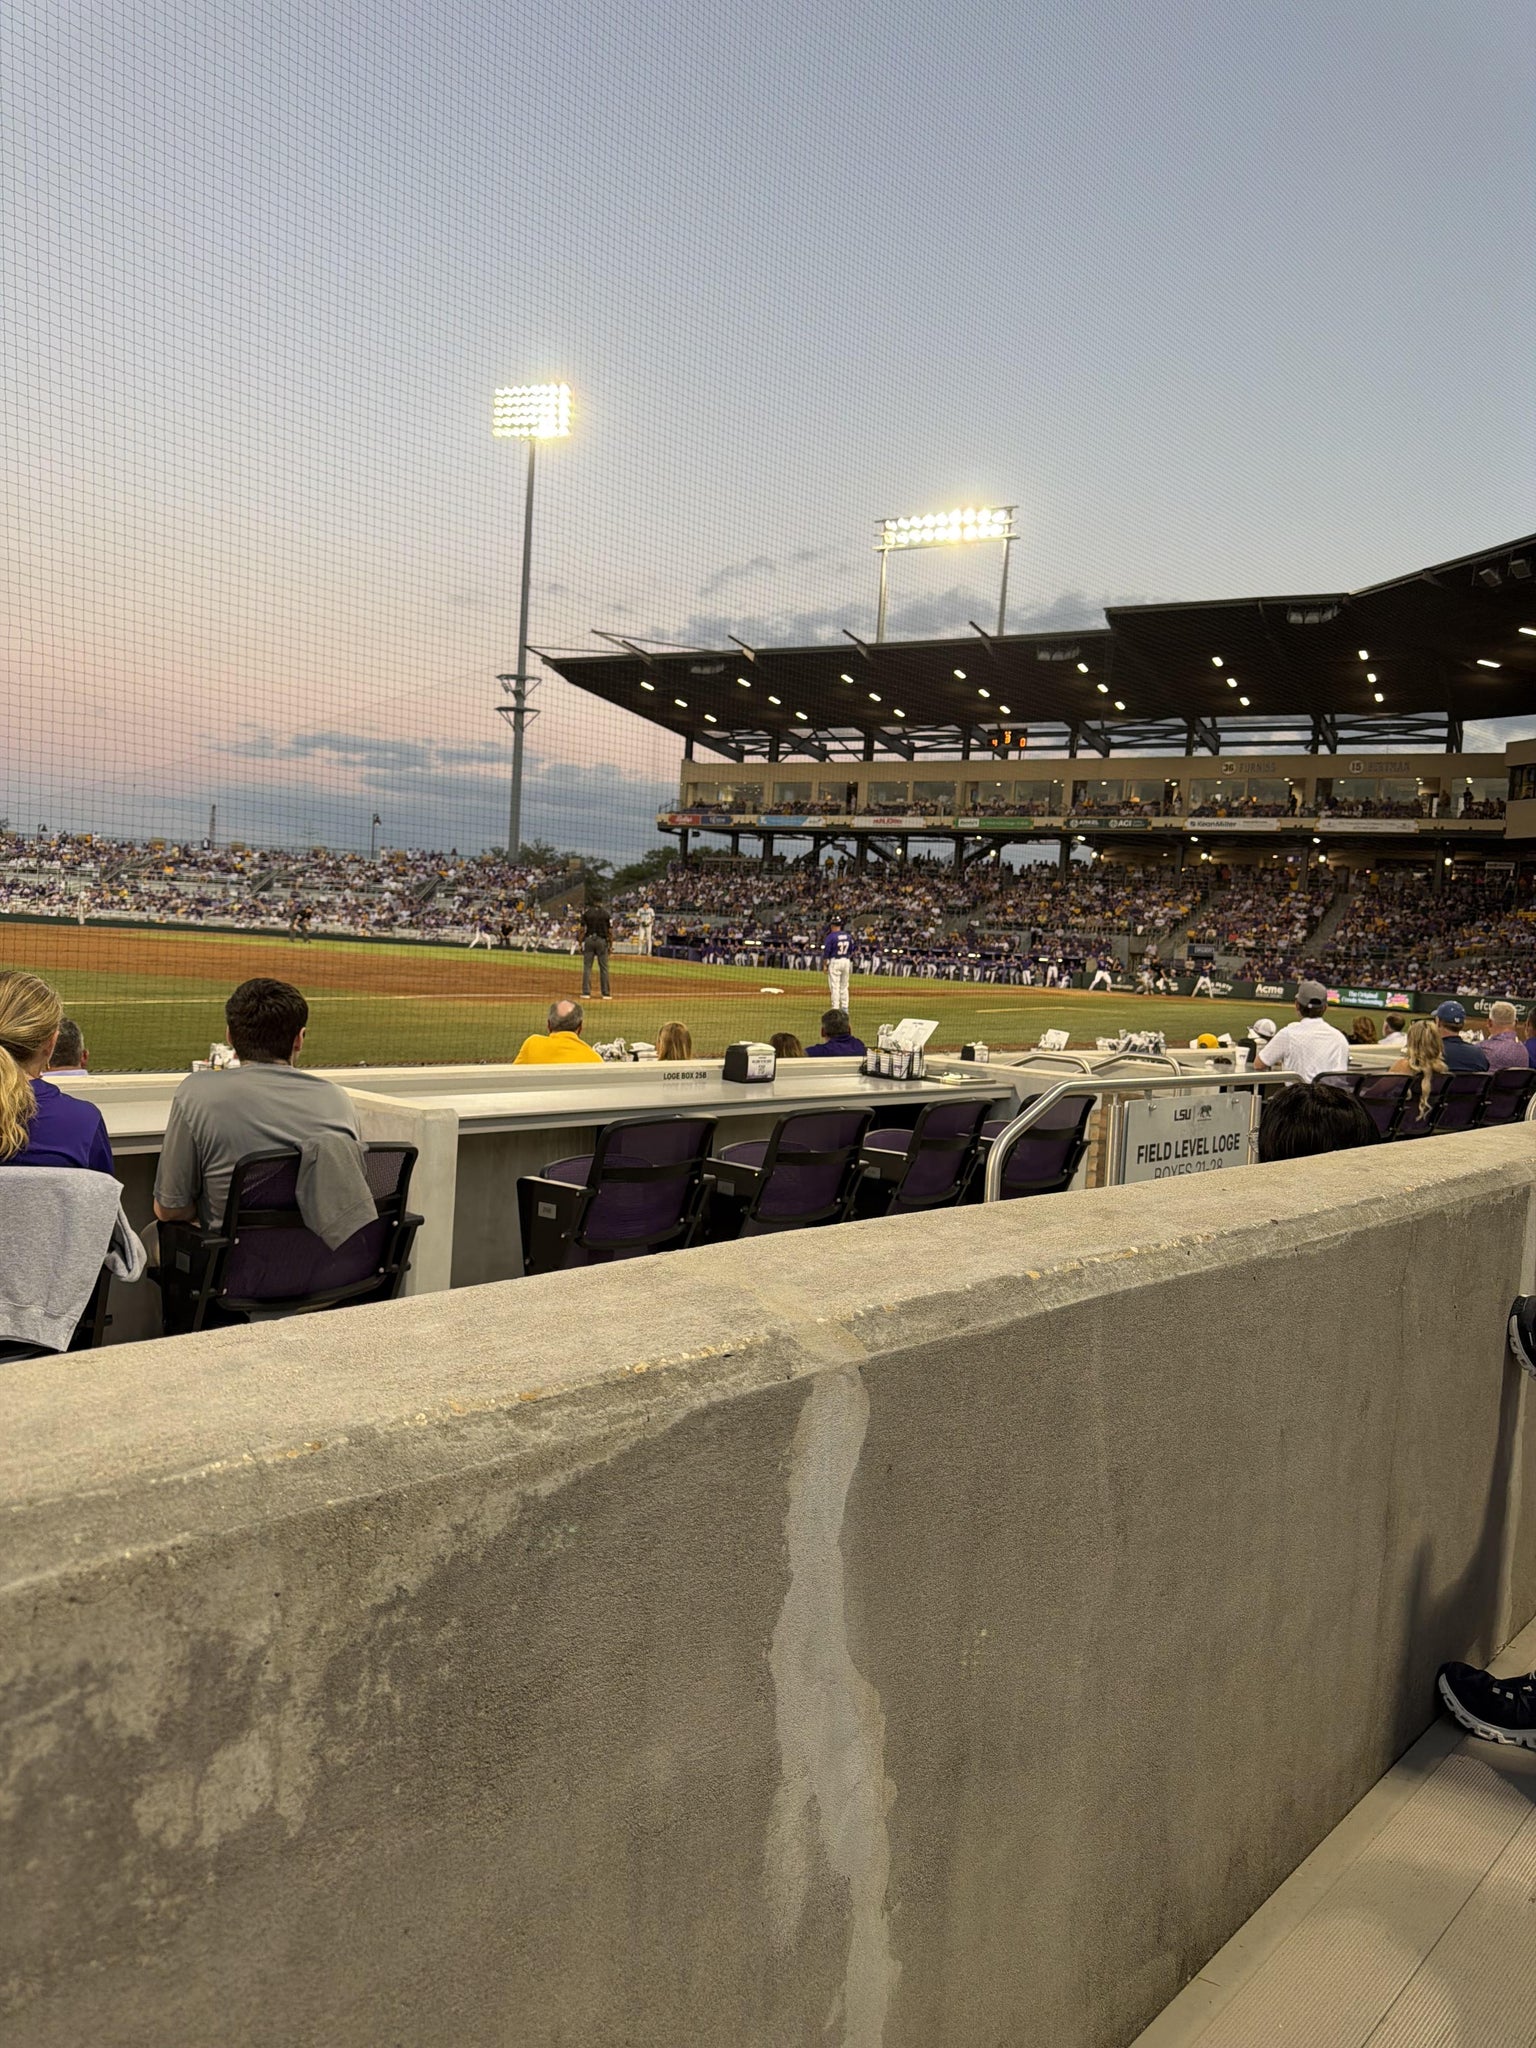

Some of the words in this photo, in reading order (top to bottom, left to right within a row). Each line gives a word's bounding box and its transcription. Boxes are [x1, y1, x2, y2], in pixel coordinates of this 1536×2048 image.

[1020, 737, 1027, 747] 0
[1223, 763, 1234, 772] 36
[1239, 762, 1276, 773] FURNISS
[1352, 763, 1361, 771] 15
[1117, 819, 1132, 828] AGI
[837, 941, 850, 955] 37
[1255, 983, 1284, 995] Acme
[663, 1072, 680, 1080] LOGE
[681, 1072, 694, 1080] BOX
[1174, 1108, 1192, 1121] LSU
[1137, 1141, 1172, 1164] FIELD
[1174, 1137, 1209, 1159] LEVEL
[1212, 1132, 1241, 1154] LOGE
